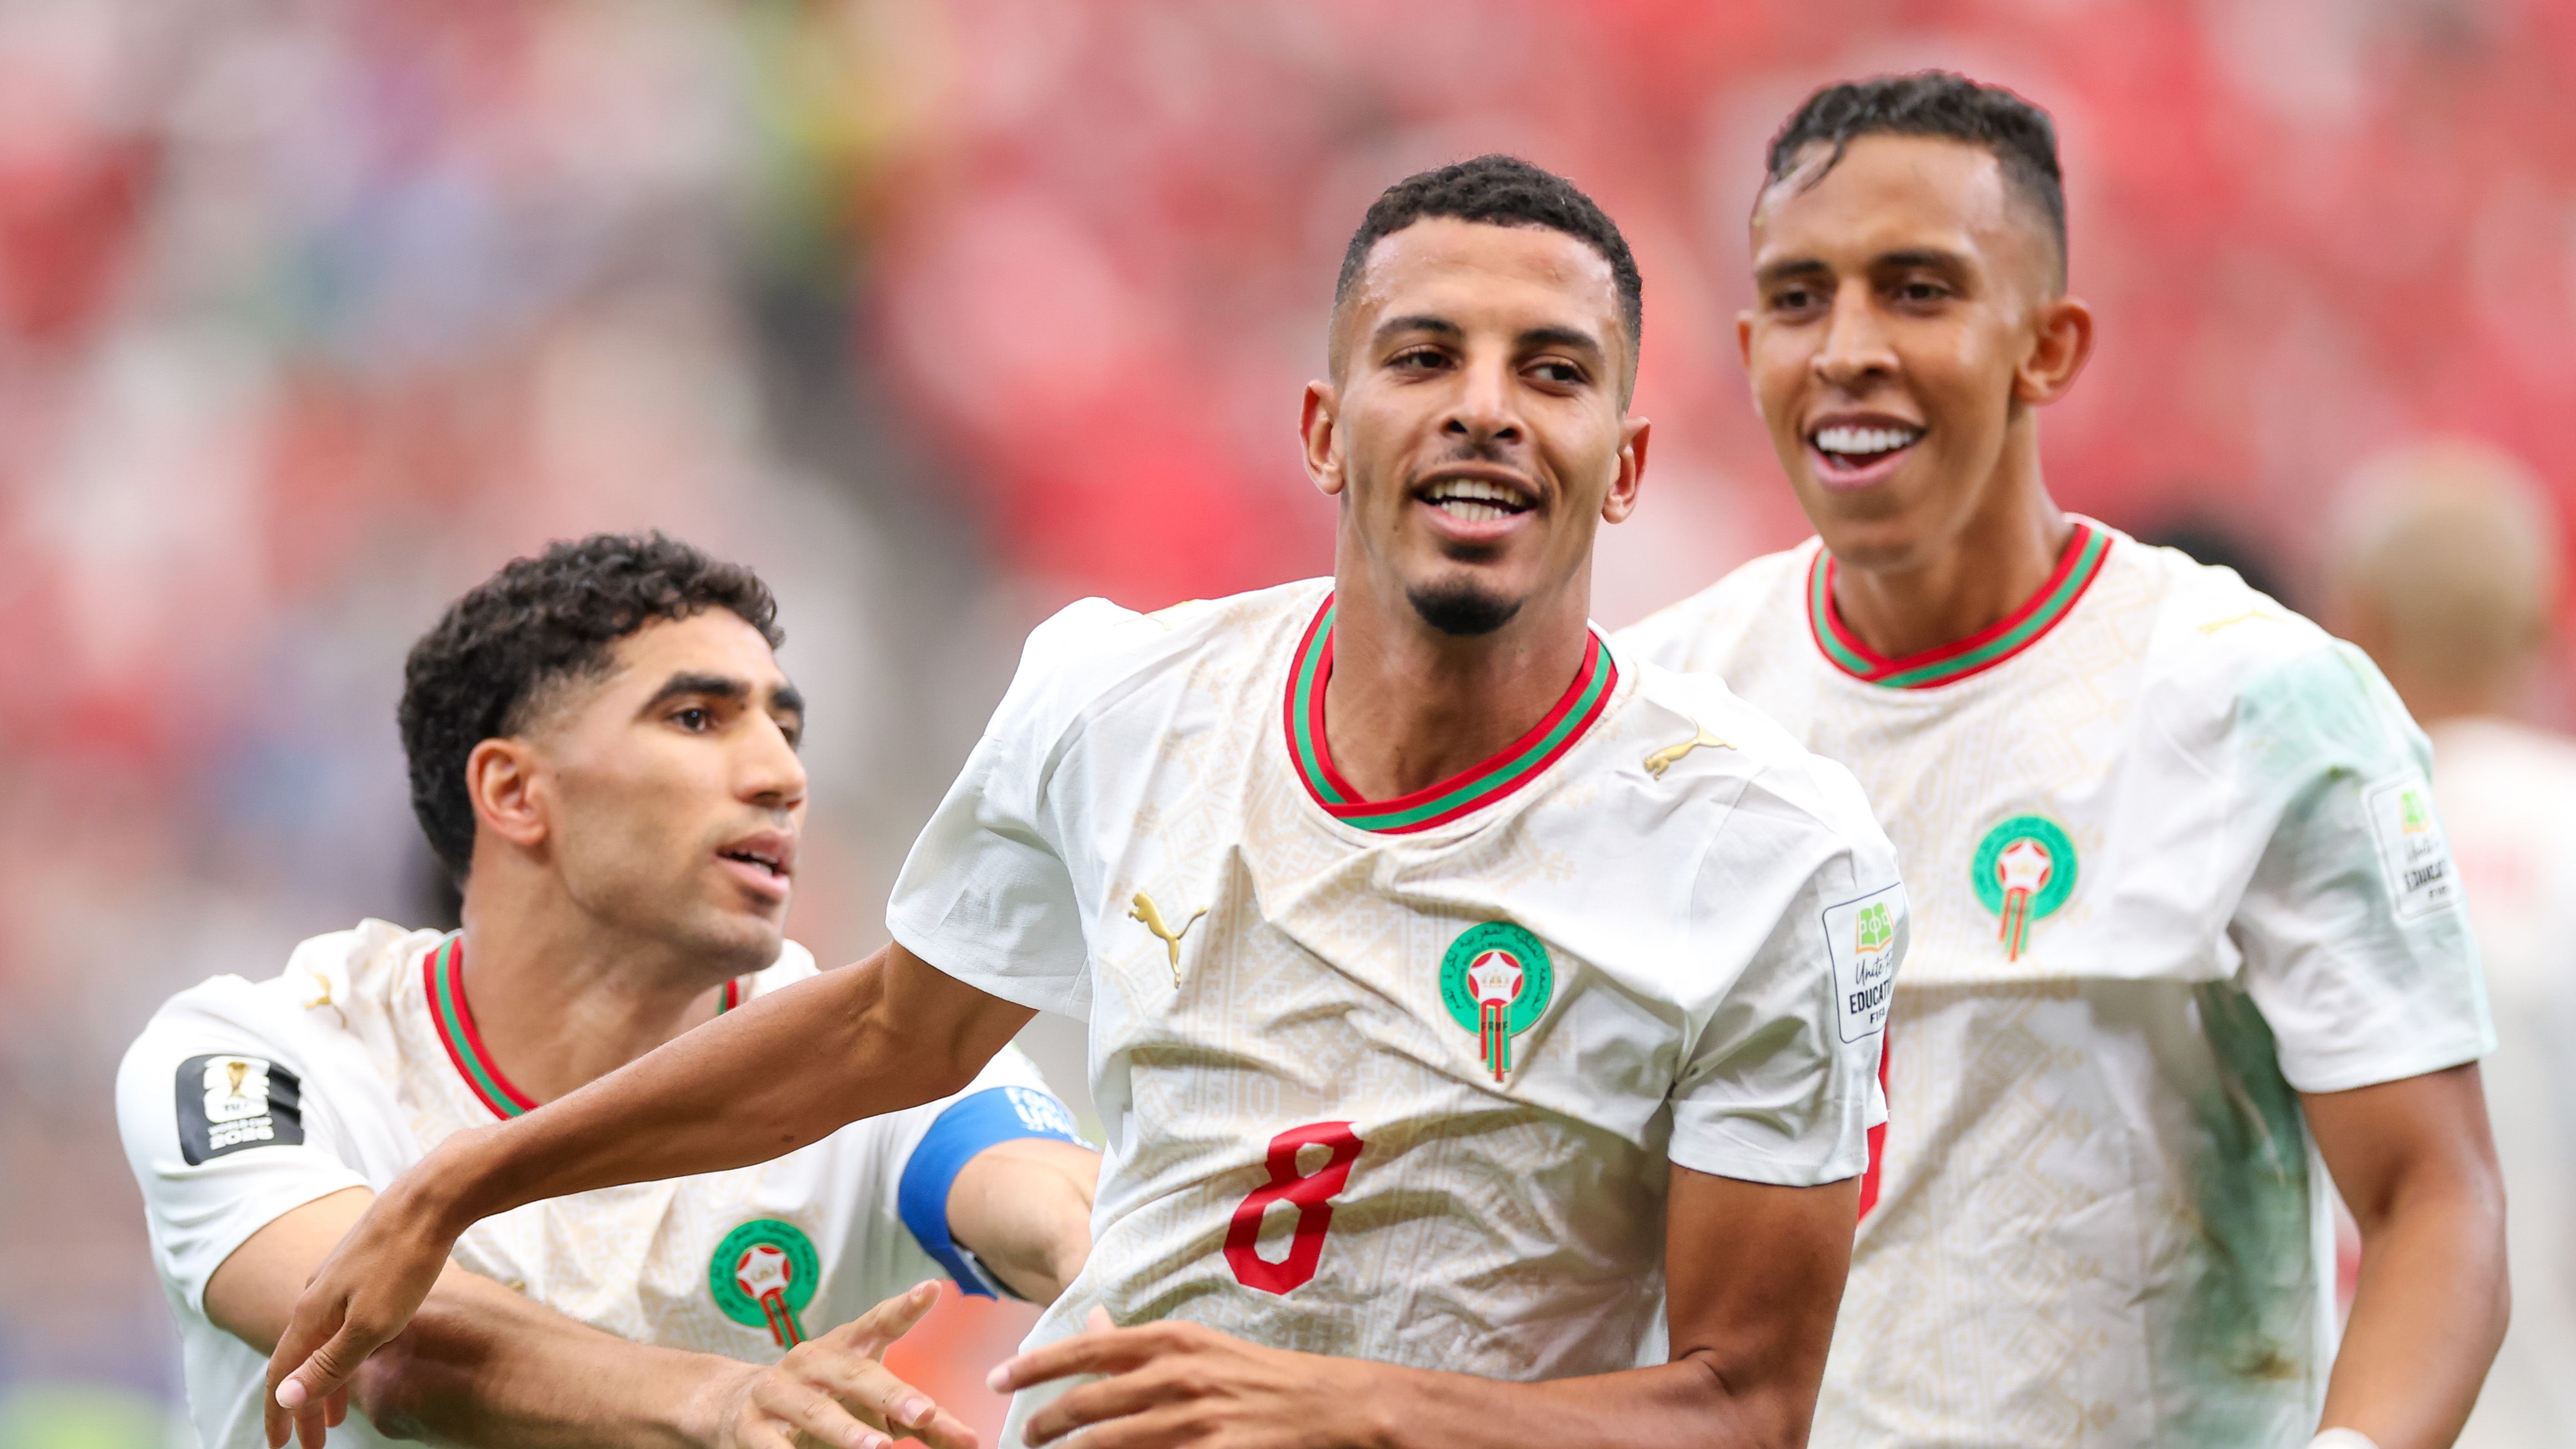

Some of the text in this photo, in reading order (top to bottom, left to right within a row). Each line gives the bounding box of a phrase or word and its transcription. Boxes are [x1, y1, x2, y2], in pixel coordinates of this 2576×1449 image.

[1856, 959, 1883, 987] Unite
[210, 1125, 274, 1150] 2026
[1222, 1121, 1364, 1296] 8
